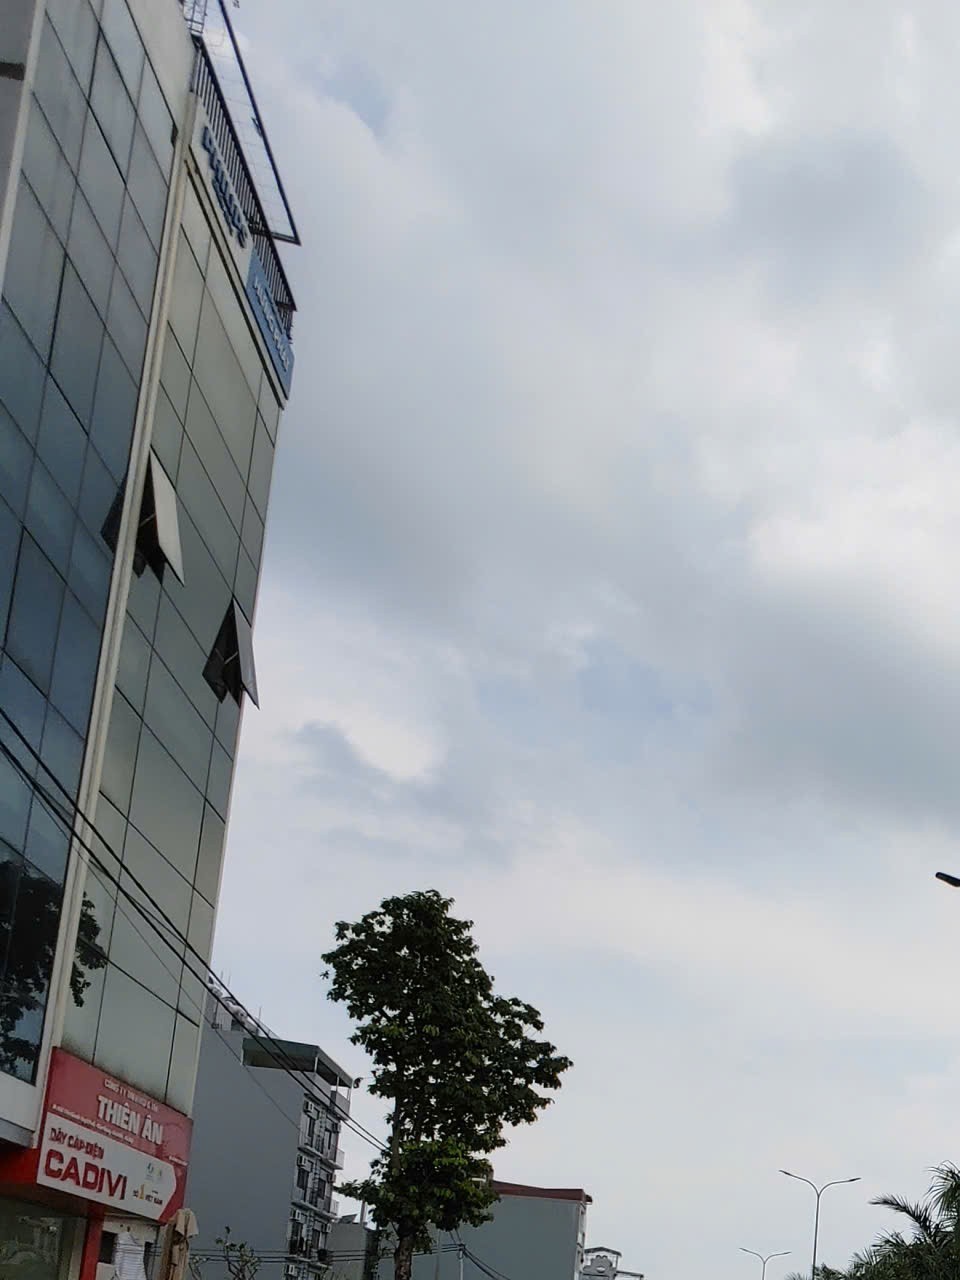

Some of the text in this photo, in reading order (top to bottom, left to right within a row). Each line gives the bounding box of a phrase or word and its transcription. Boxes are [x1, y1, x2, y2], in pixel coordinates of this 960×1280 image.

[97, 1094, 141, 1136] THIÊN
[141, 1114, 163, 1145] ÂN
[44, 1149, 128, 1201] CADIVI
